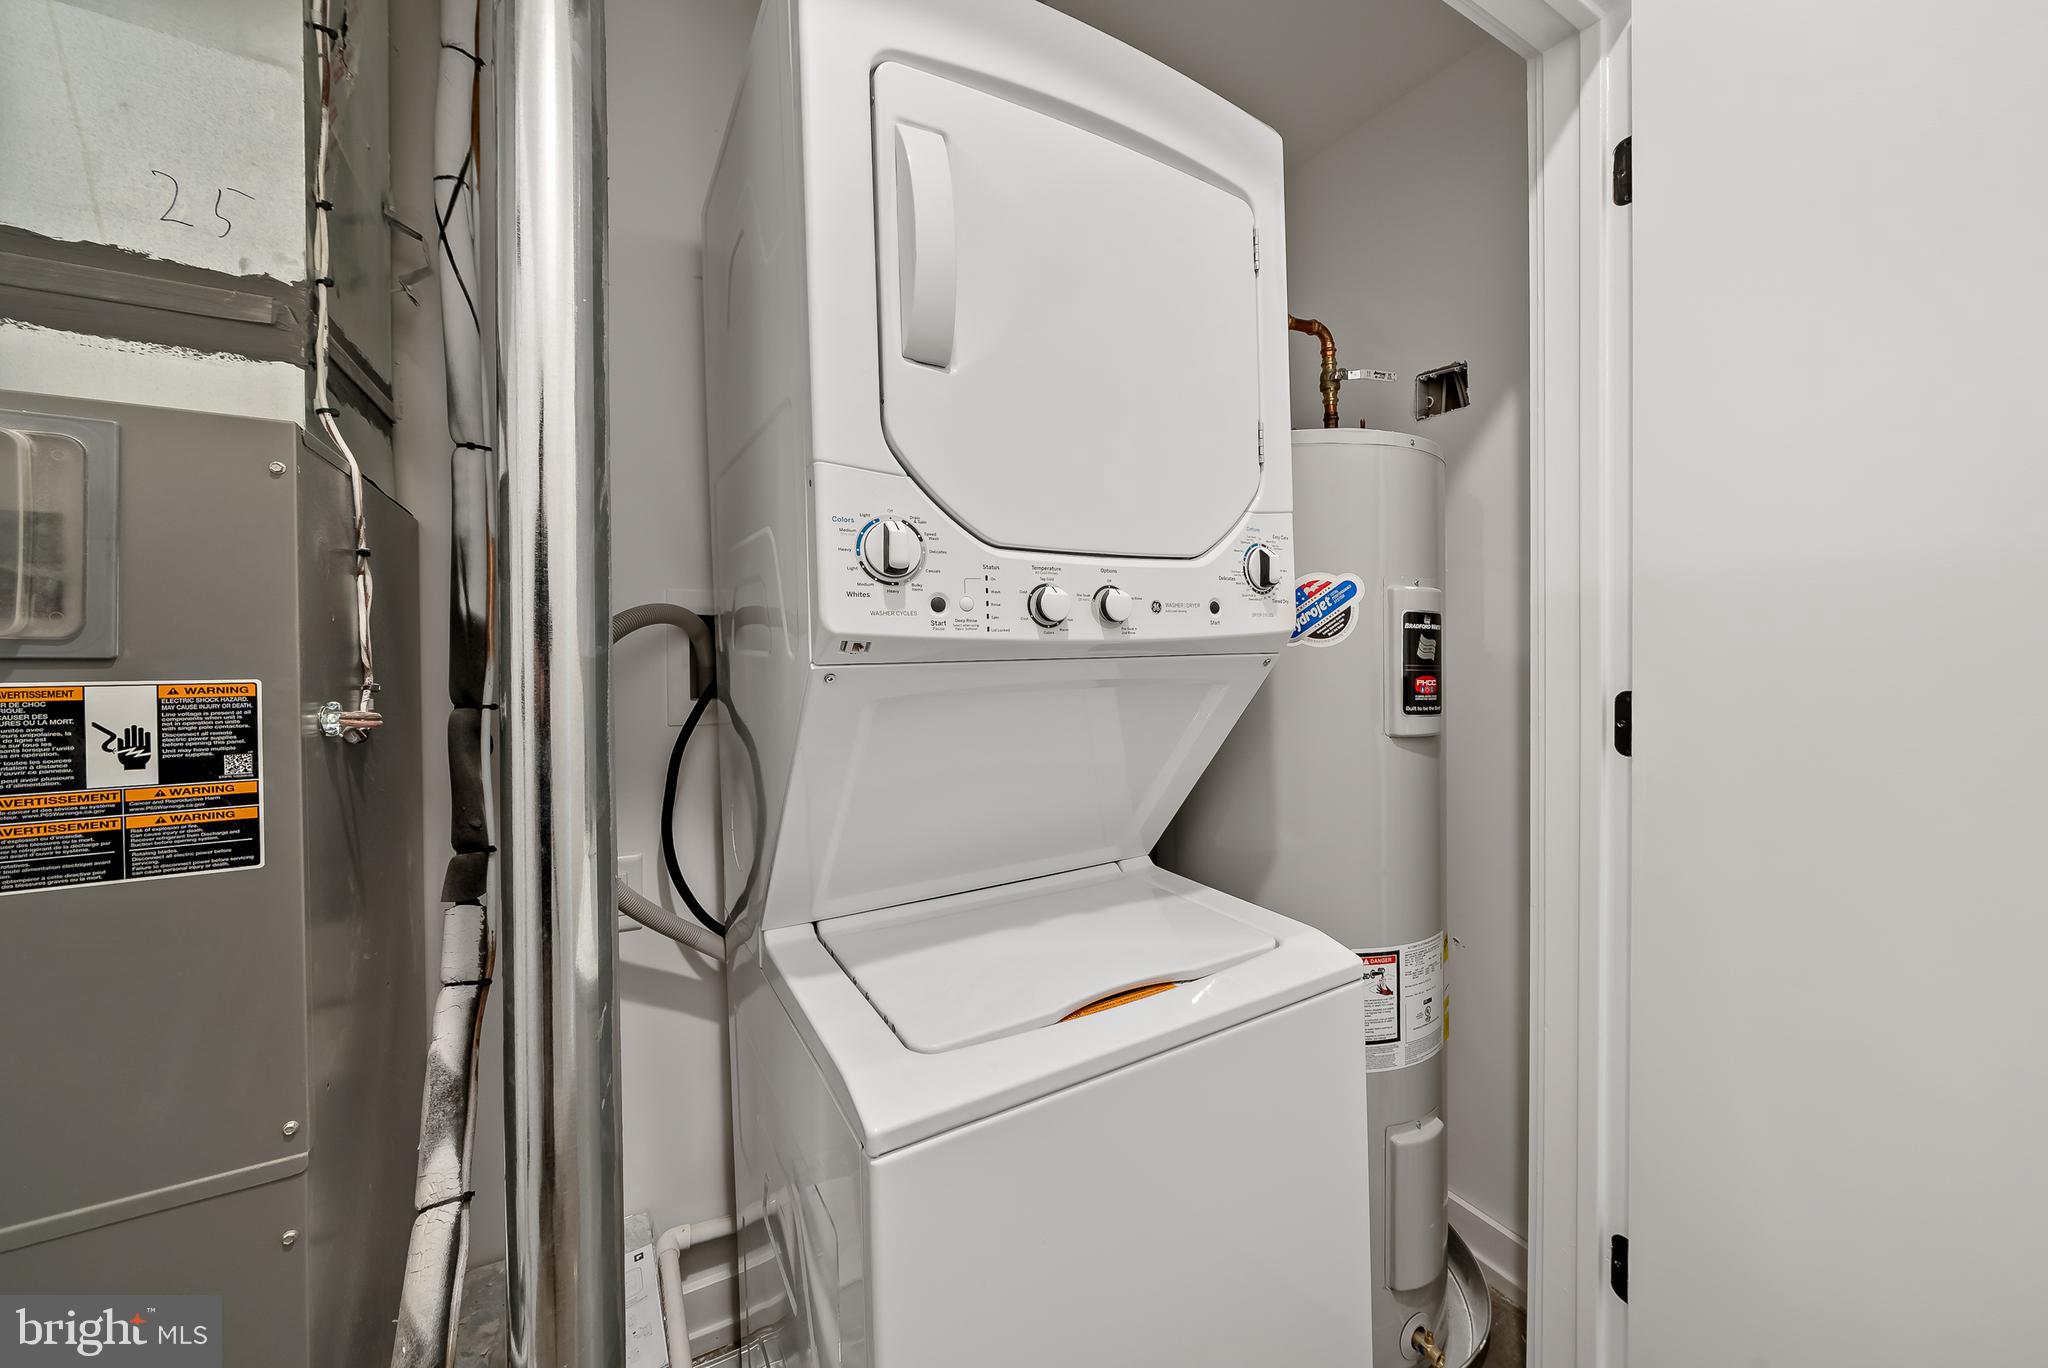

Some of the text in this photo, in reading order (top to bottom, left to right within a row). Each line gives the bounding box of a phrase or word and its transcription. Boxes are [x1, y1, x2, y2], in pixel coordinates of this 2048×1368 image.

[1296, 596, 1332, 632] ydrojet
[0, 690, 74, 699] VERTISSEMENT
[184, 686, 249, 695] WARNING
[169, 785, 234, 796] WARNING
[170, 811, 235, 822] WARNING
